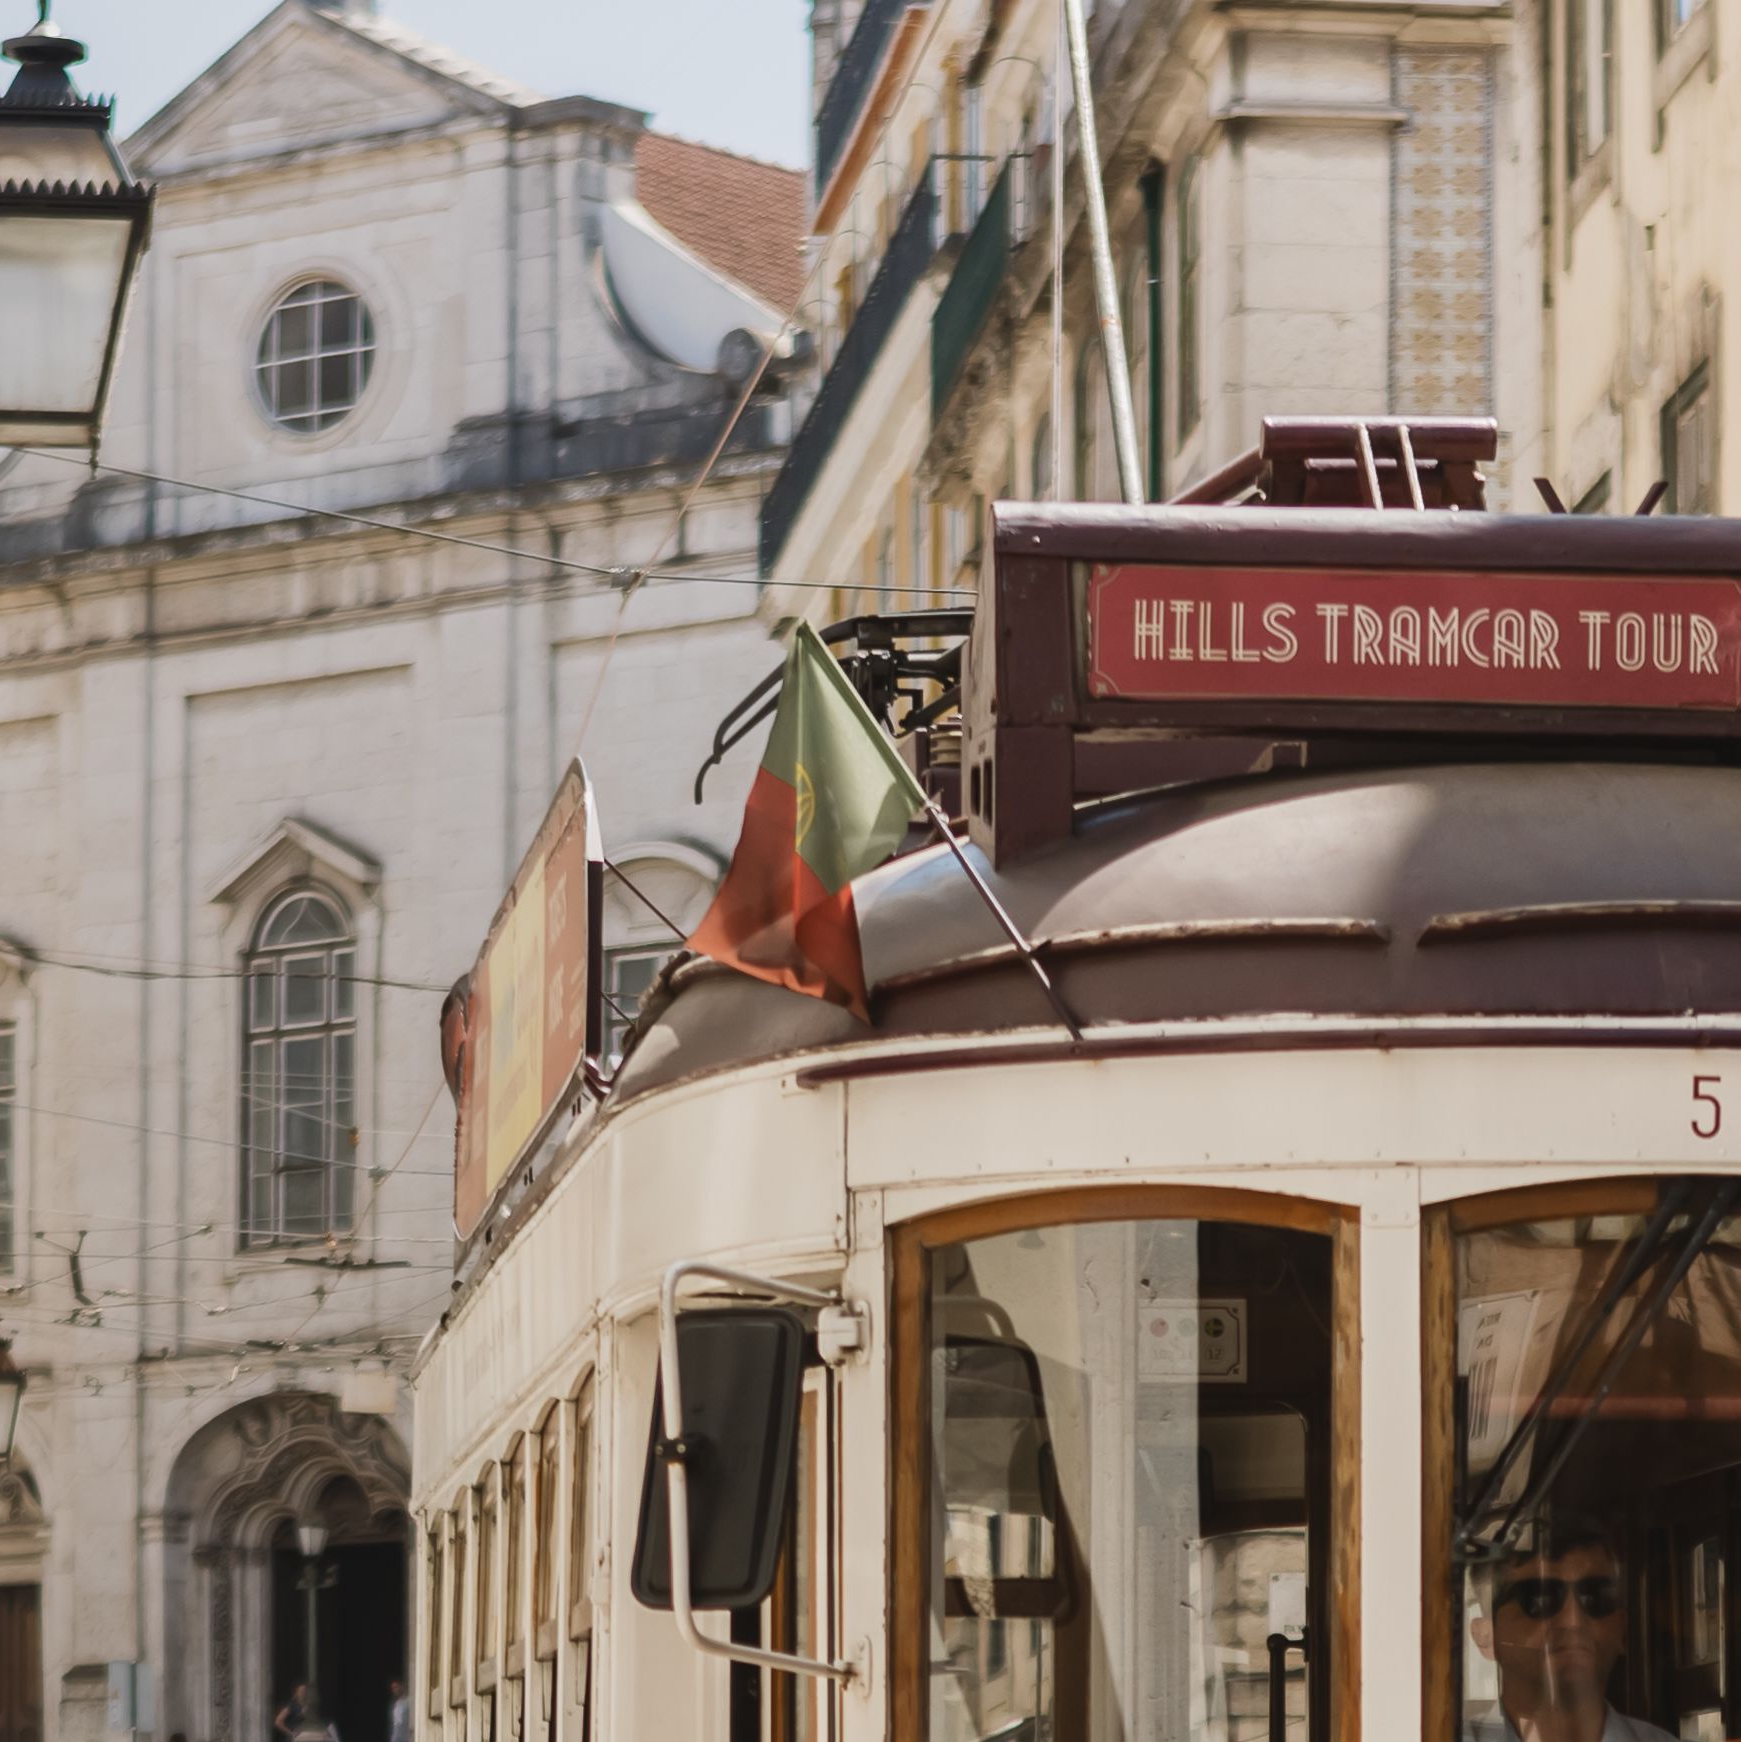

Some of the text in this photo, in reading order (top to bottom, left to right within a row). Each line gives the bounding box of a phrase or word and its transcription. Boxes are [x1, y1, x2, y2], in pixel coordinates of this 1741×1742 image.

[1134, 599, 1720, 674] HILLS TRAMCAR TOUR
[1691, 1074, 1722, 1140] 5
